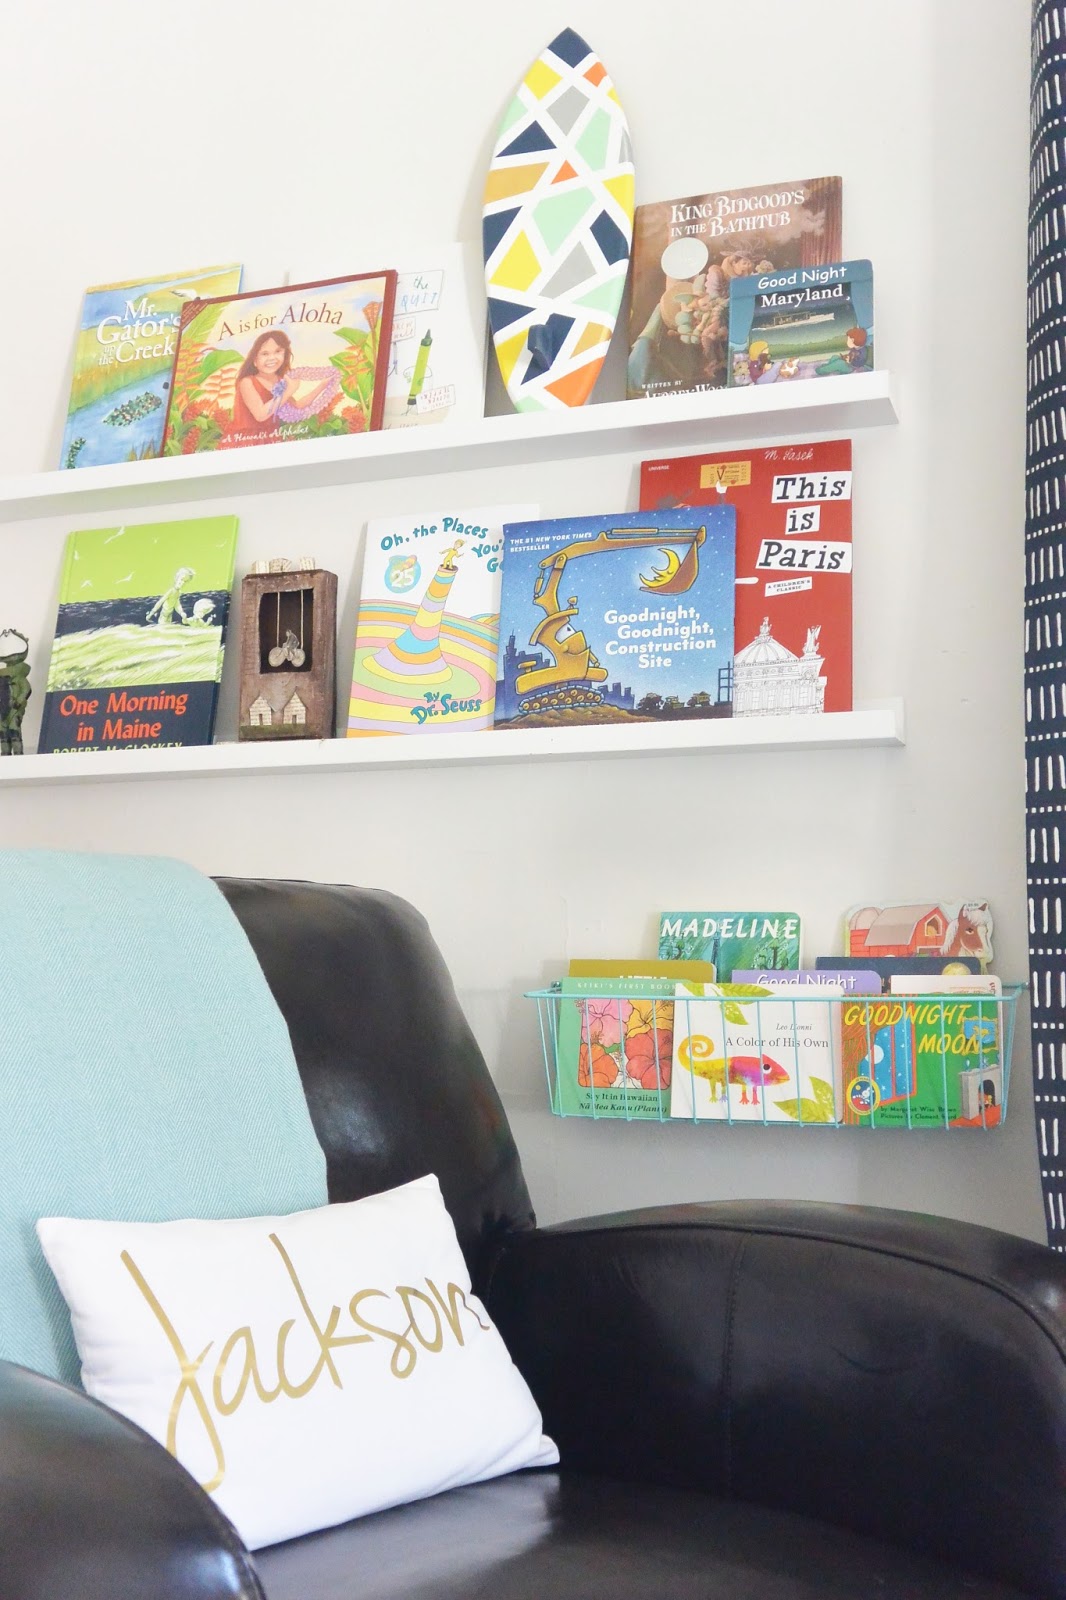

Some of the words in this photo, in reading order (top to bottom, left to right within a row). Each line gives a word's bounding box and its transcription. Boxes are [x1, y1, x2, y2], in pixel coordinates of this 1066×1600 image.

[671, 203, 713, 224] KING
[717, 190, 805, 215] BIDGOOD'S
[684, 223, 706, 236] THE
[710, 211, 791, 237] BATHTUB
[414, 275, 429, 290] the
[758, 273, 798, 290] Good
[802, 266, 847, 283] Night
[760, 285, 844, 308] Maryland
[124, 297, 158, 321] Mr.
[97, 313, 181, 345] Gator's
[218, 321, 234, 341] A
[240, 318, 250, 333] is
[254, 312, 277, 331] for
[281, 302, 344, 325] Aloha
[116, 334, 176, 363] Creek
[775, 476, 846, 500] This
[413, 525, 438, 538] the
[442, 517, 489, 539] Places
[788, 510, 815, 534] is
[510, 544, 550, 553] BESTSELLER
[759, 541, 844, 571] Paris
[604, 606, 700, 624] Goodnight,
[617, 620, 714, 640] Goodnight,
[605, 639, 717, 656] Construction
[638, 654, 673, 669] Site
[60, 695, 99, 717] One
[106, 690, 189, 716] Morning
[410, 704, 439, 725] Dr.
[441, 693, 482, 715] Seuss
[424, 692, 440, 703] By
[76, 722, 95, 742] in
[102, 718, 162, 740] Maine
[661, 918, 799, 939] MADELINE
[844, 1003, 972, 1026] GOODNIGHT
[725, 1037, 733, 1046] A
[736, 1037, 766, 1047] Color
[768, 1038, 781, 1047] of
[783, 1038, 801, 1048] His
[803, 1037, 829, 1048] Own
[918, 1033, 980, 1055] MOON
[120, 1232, 490, 1493] Jackson
